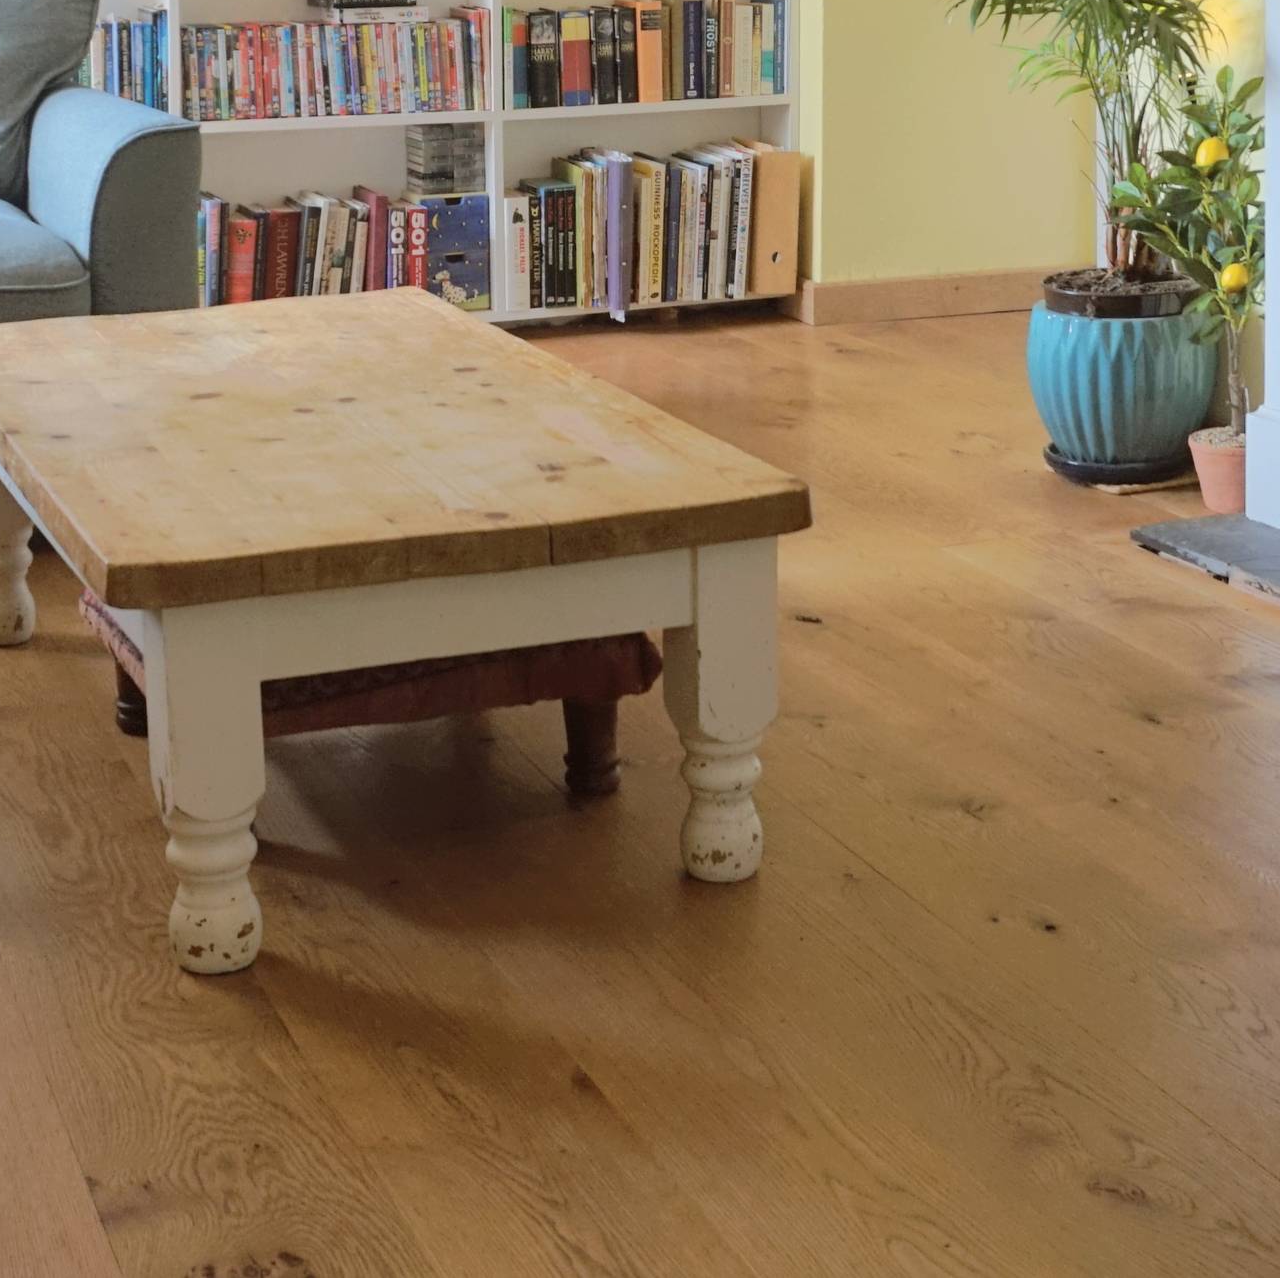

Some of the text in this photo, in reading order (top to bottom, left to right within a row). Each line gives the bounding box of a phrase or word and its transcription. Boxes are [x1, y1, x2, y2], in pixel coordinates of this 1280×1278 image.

[706, 18, 716, 54] FROST
[390, 210, 405, 254] 501
[411, 212, 426, 256] 501
[652, 170, 662, 286] GUINNESS ROCKOPEDIA
[276, 242, 288, 299] LAWREN
